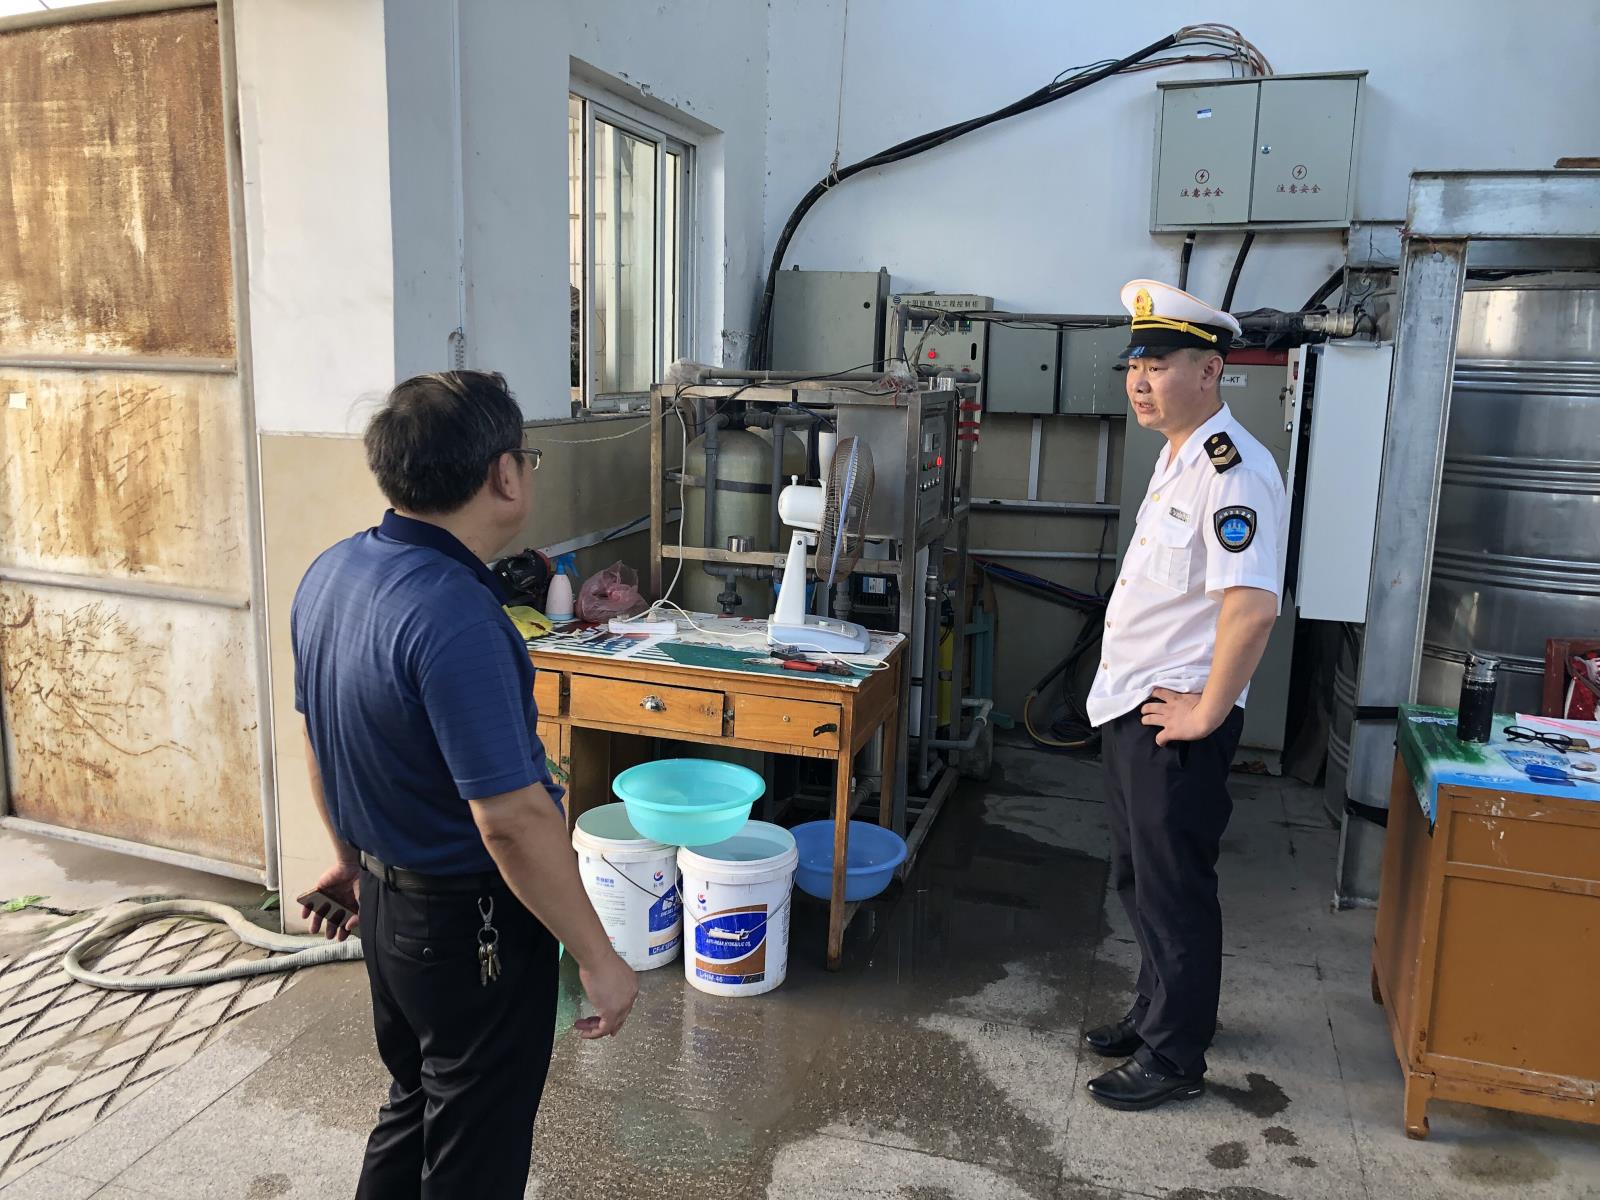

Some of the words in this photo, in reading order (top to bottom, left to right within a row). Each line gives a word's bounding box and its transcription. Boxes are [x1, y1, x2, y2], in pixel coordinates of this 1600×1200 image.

[1180, 187, 1224, 198] 注意安全
[1276, 184, 1321, 194] 注意安全
